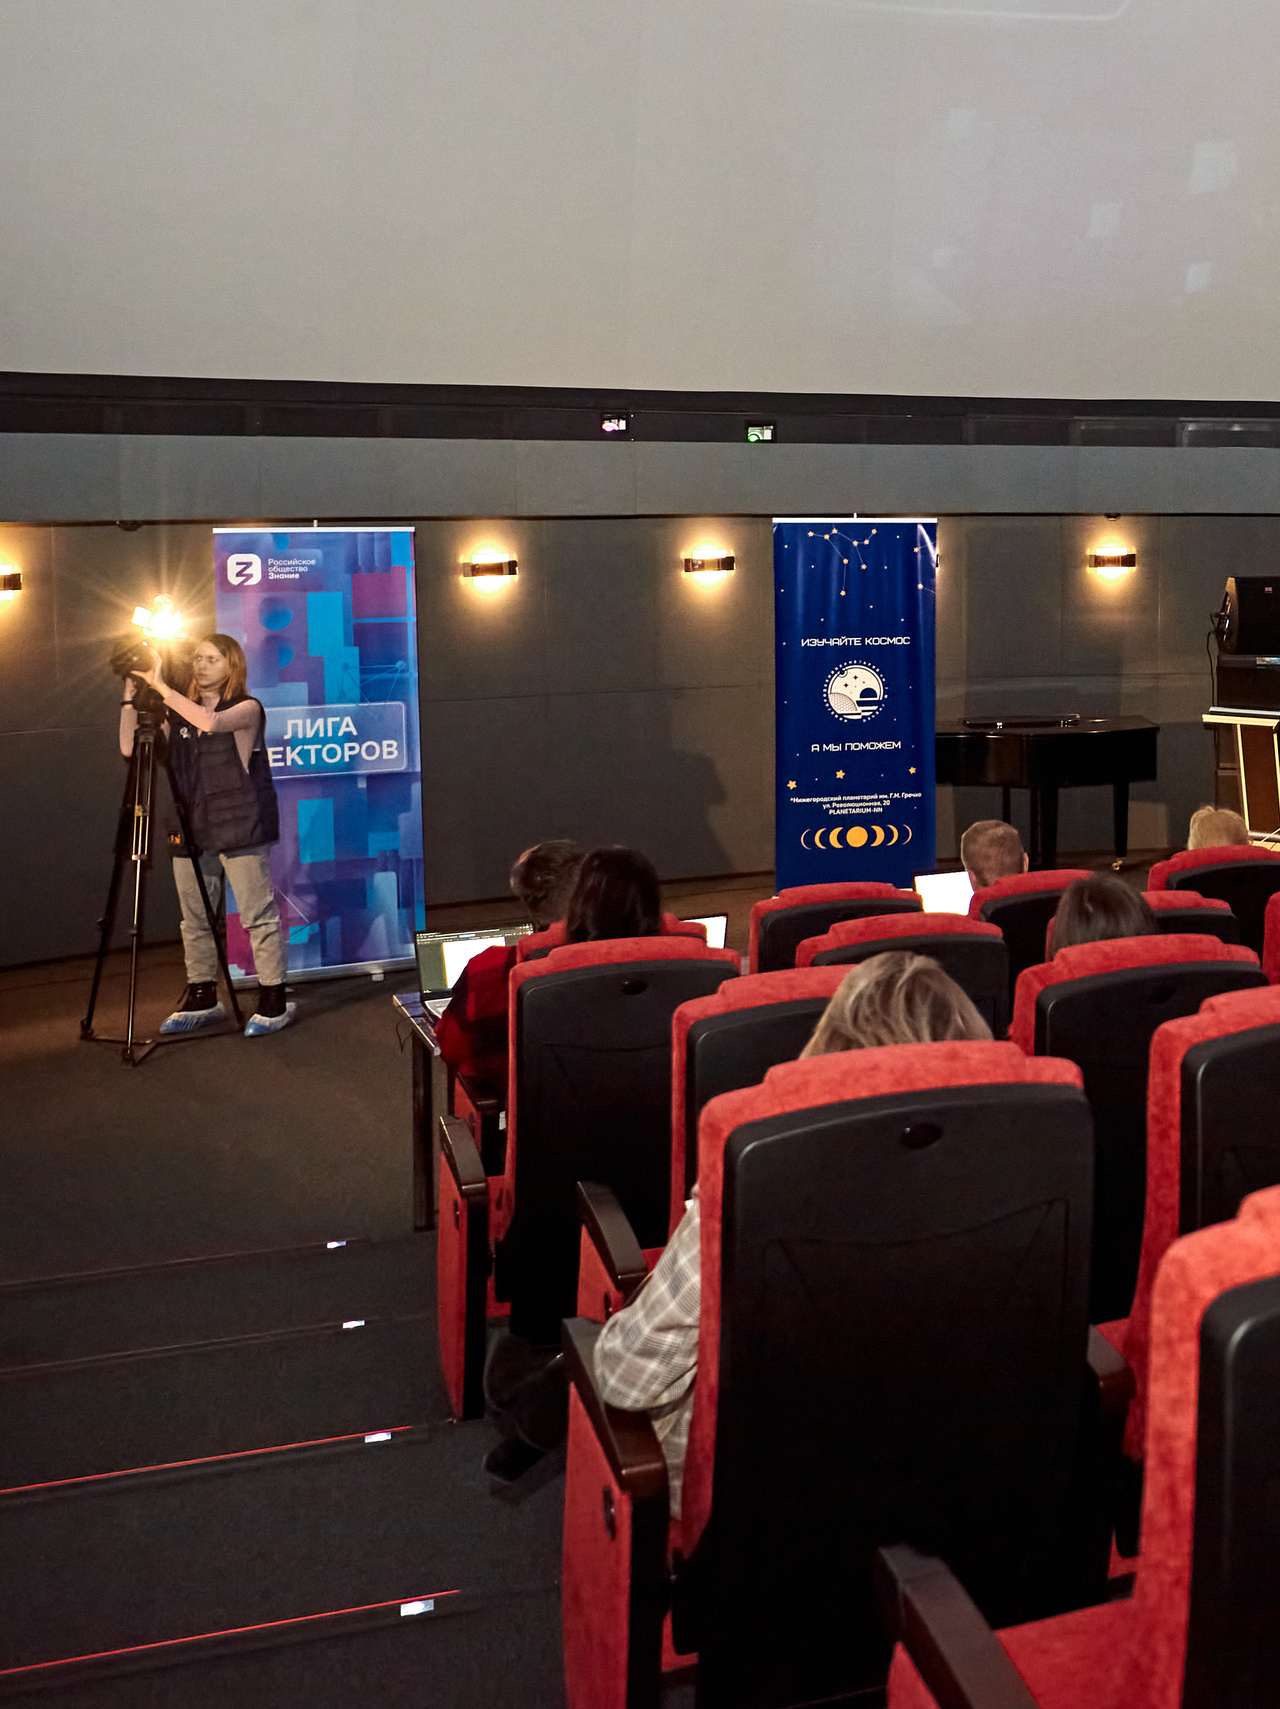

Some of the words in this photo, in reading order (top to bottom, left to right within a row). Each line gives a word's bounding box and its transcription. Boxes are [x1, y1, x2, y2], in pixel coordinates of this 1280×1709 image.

[268, 558, 316, 566] Российское
[268, 572, 300, 580] Знание
[801, 636, 862, 647] ИЗУЧАЙТЕ
[865, 636, 911, 646] КОСМОС
[284, 716, 358, 740] ЛИГА
[811, 743, 820, 753] А
[823, 743, 842, 752] МЫ
[845, 741, 902, 751] ПОМОЖЕМ
[266, 740, 399, 767] ЕКТОРОВ
[829, 807, 883, 815] PLANETARIUM-NN
